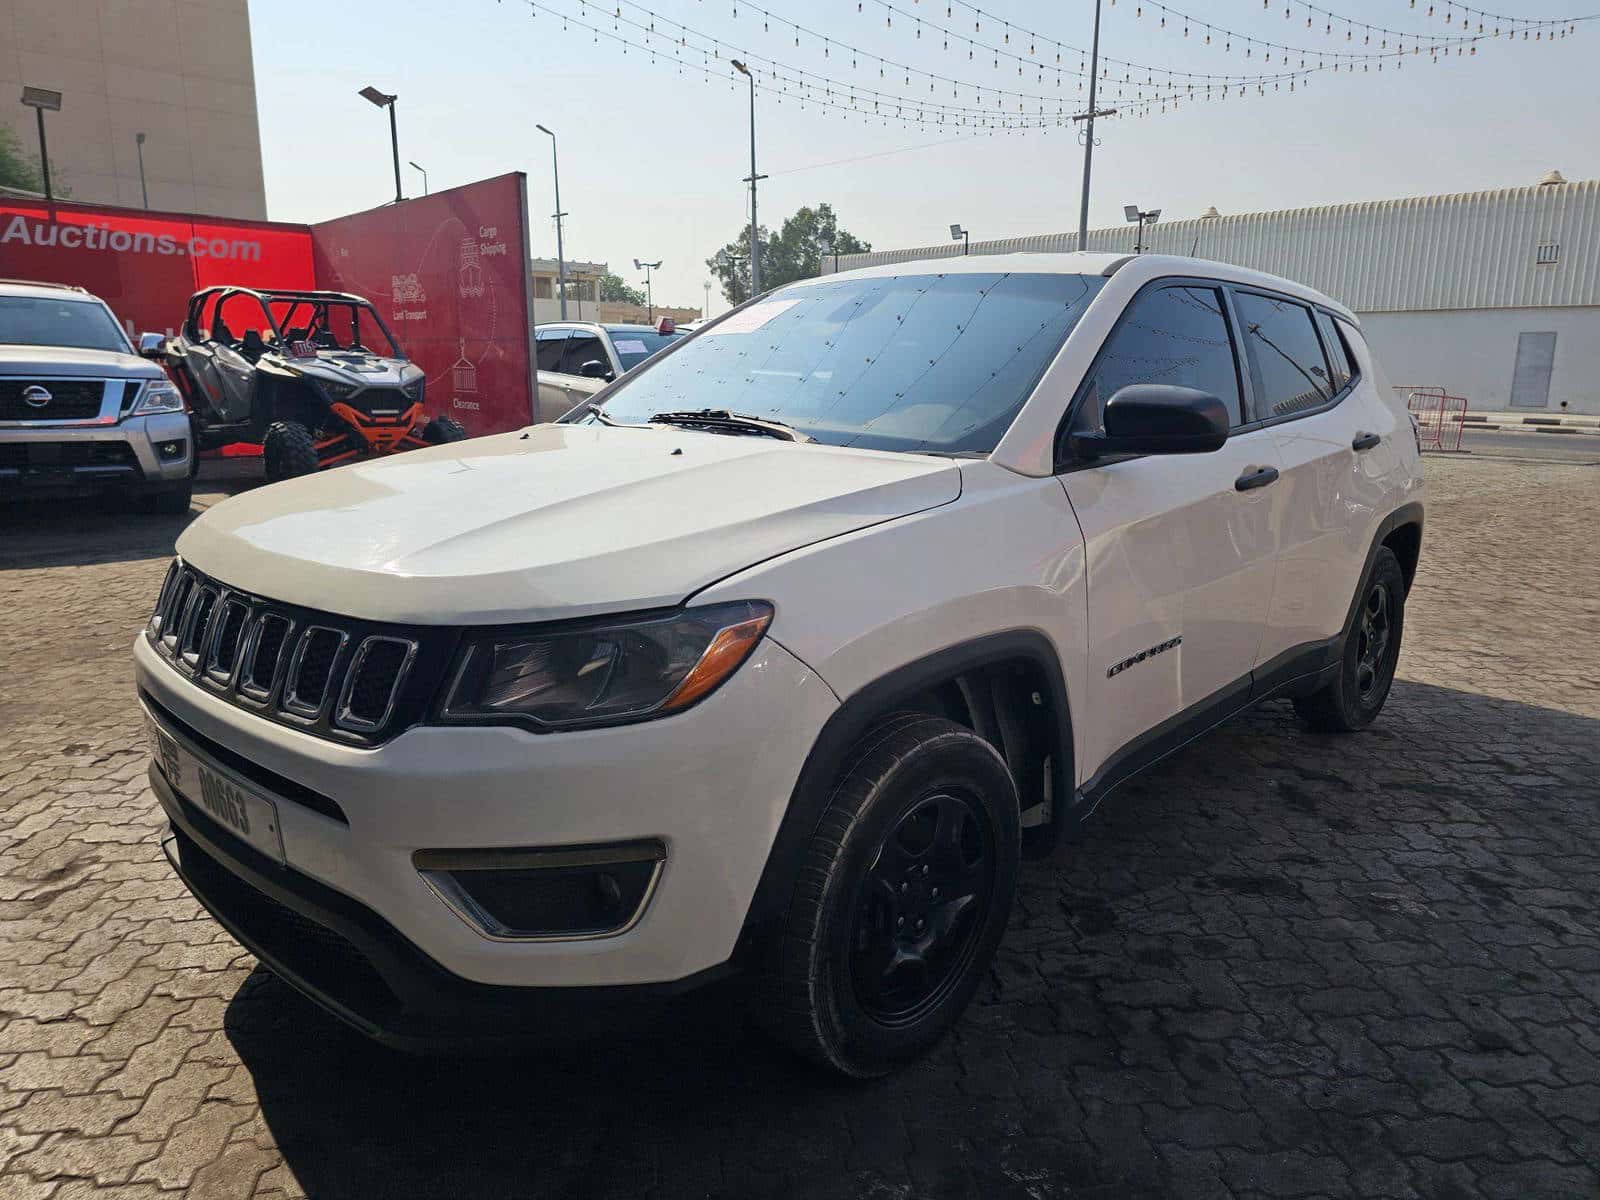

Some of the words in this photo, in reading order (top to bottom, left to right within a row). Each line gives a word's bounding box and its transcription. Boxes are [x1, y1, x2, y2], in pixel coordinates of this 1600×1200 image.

[1, 216, 261, 261] Auctions.com
[479, 225, 497, 239] Cargo
[480, 242, 506, 256] Shipping
[453, 398, 480, 410] Clearance
